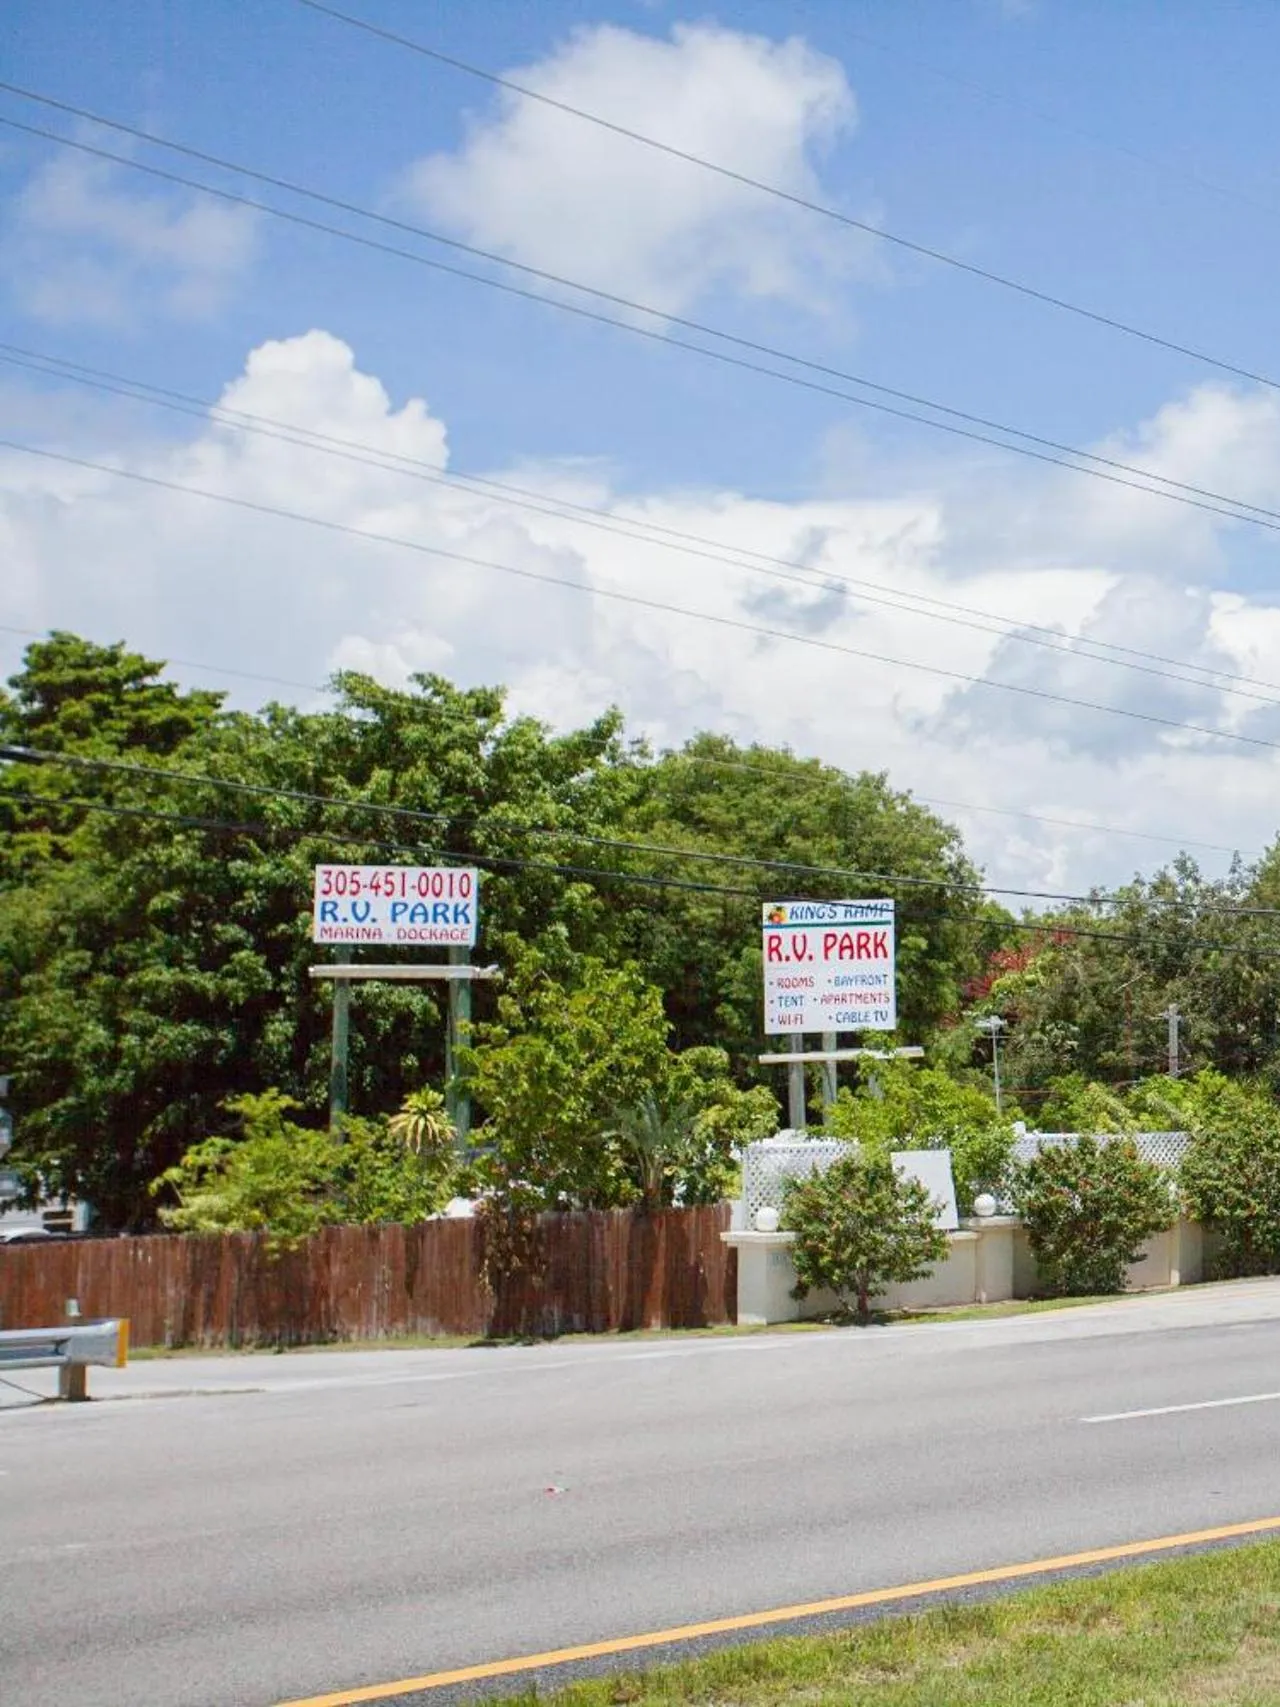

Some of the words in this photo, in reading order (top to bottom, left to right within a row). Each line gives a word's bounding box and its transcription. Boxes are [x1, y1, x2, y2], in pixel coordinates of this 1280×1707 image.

[321, 870, 471, 899] 305-451-0010
[320, 900, 377, 923] R.V.
[391, 902, 471, 925] PARK
[320, 927, 383, 940] MARINA
[397, 928, 469, 941] DOCKAGE
[767, 933, 814, 962] R.V.
[823, 931, 889, 961] PARK
[777, 976, 815, 989] ROOMS
[834, 974, 888, 987] BAYFRONT
[778, 995, 804, 1008] TENT
[820, 992, 890, 1005] APARTMENTS
[835, 1011, 871, 1024] CABLE
[873, 1010, 888, 1022] TV
